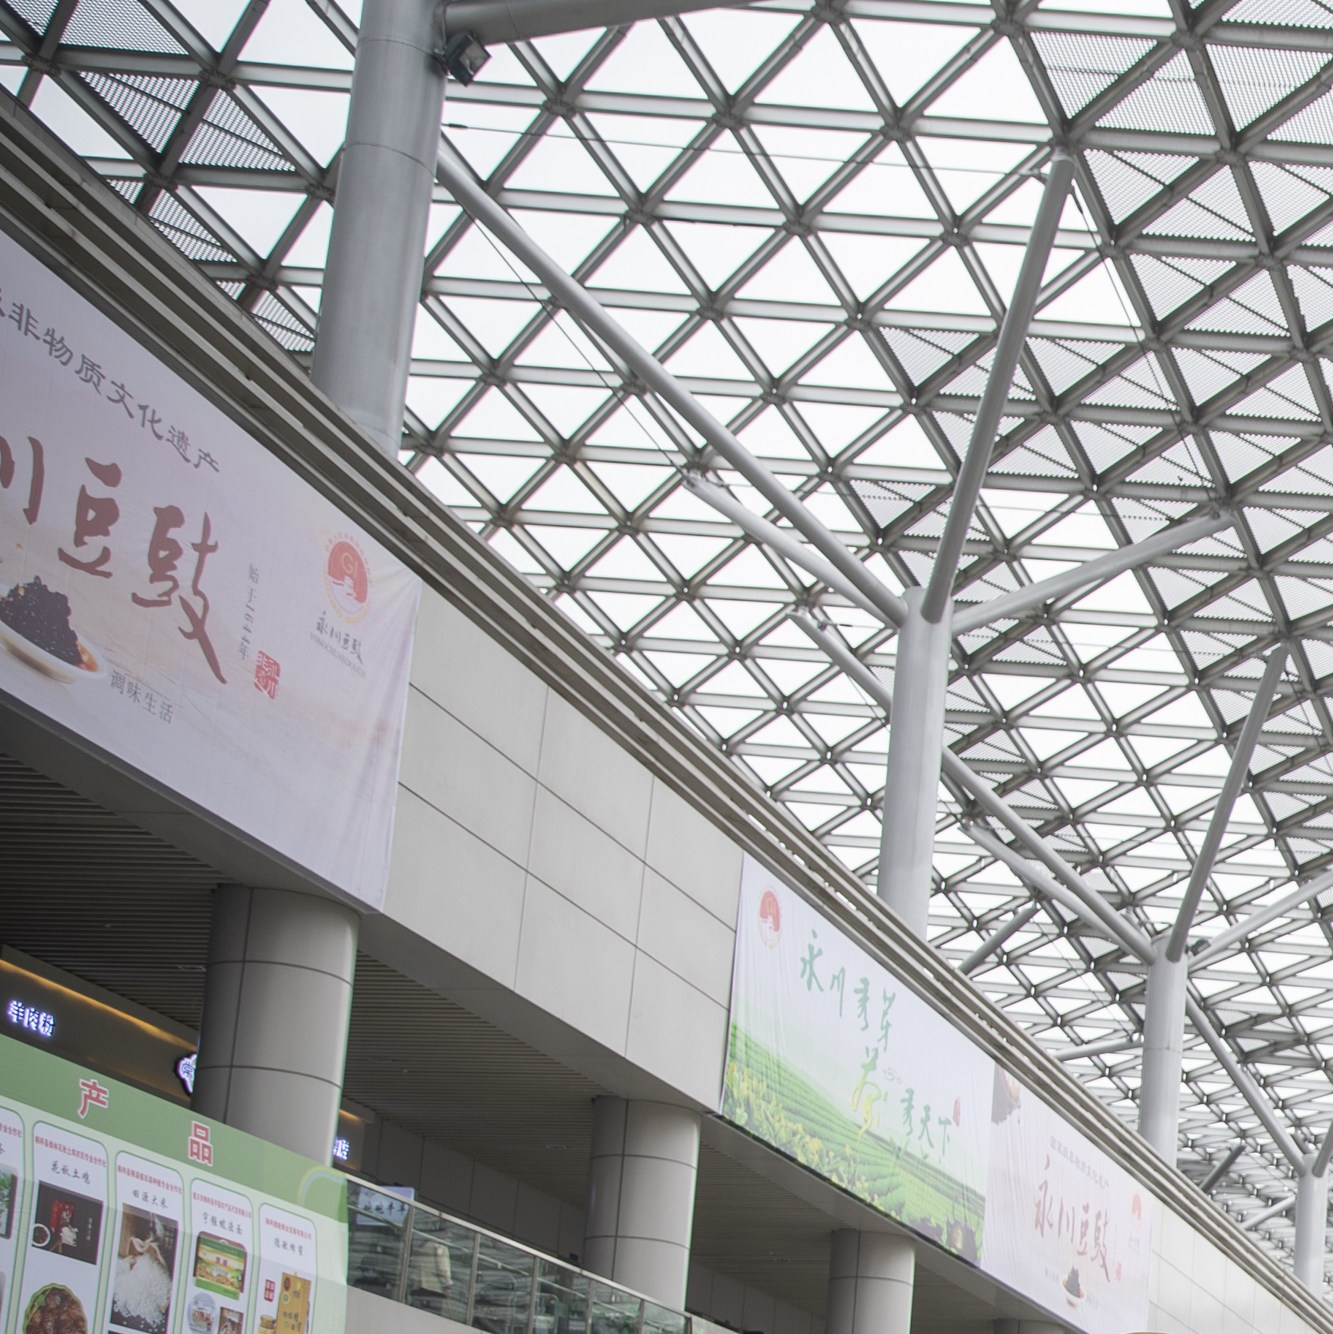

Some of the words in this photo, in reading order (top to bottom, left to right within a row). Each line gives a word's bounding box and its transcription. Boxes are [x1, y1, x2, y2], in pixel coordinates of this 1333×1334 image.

[109, 669, 174, 725] 调味生活
[8, 1000, 55, 1037] 羊肉粉
